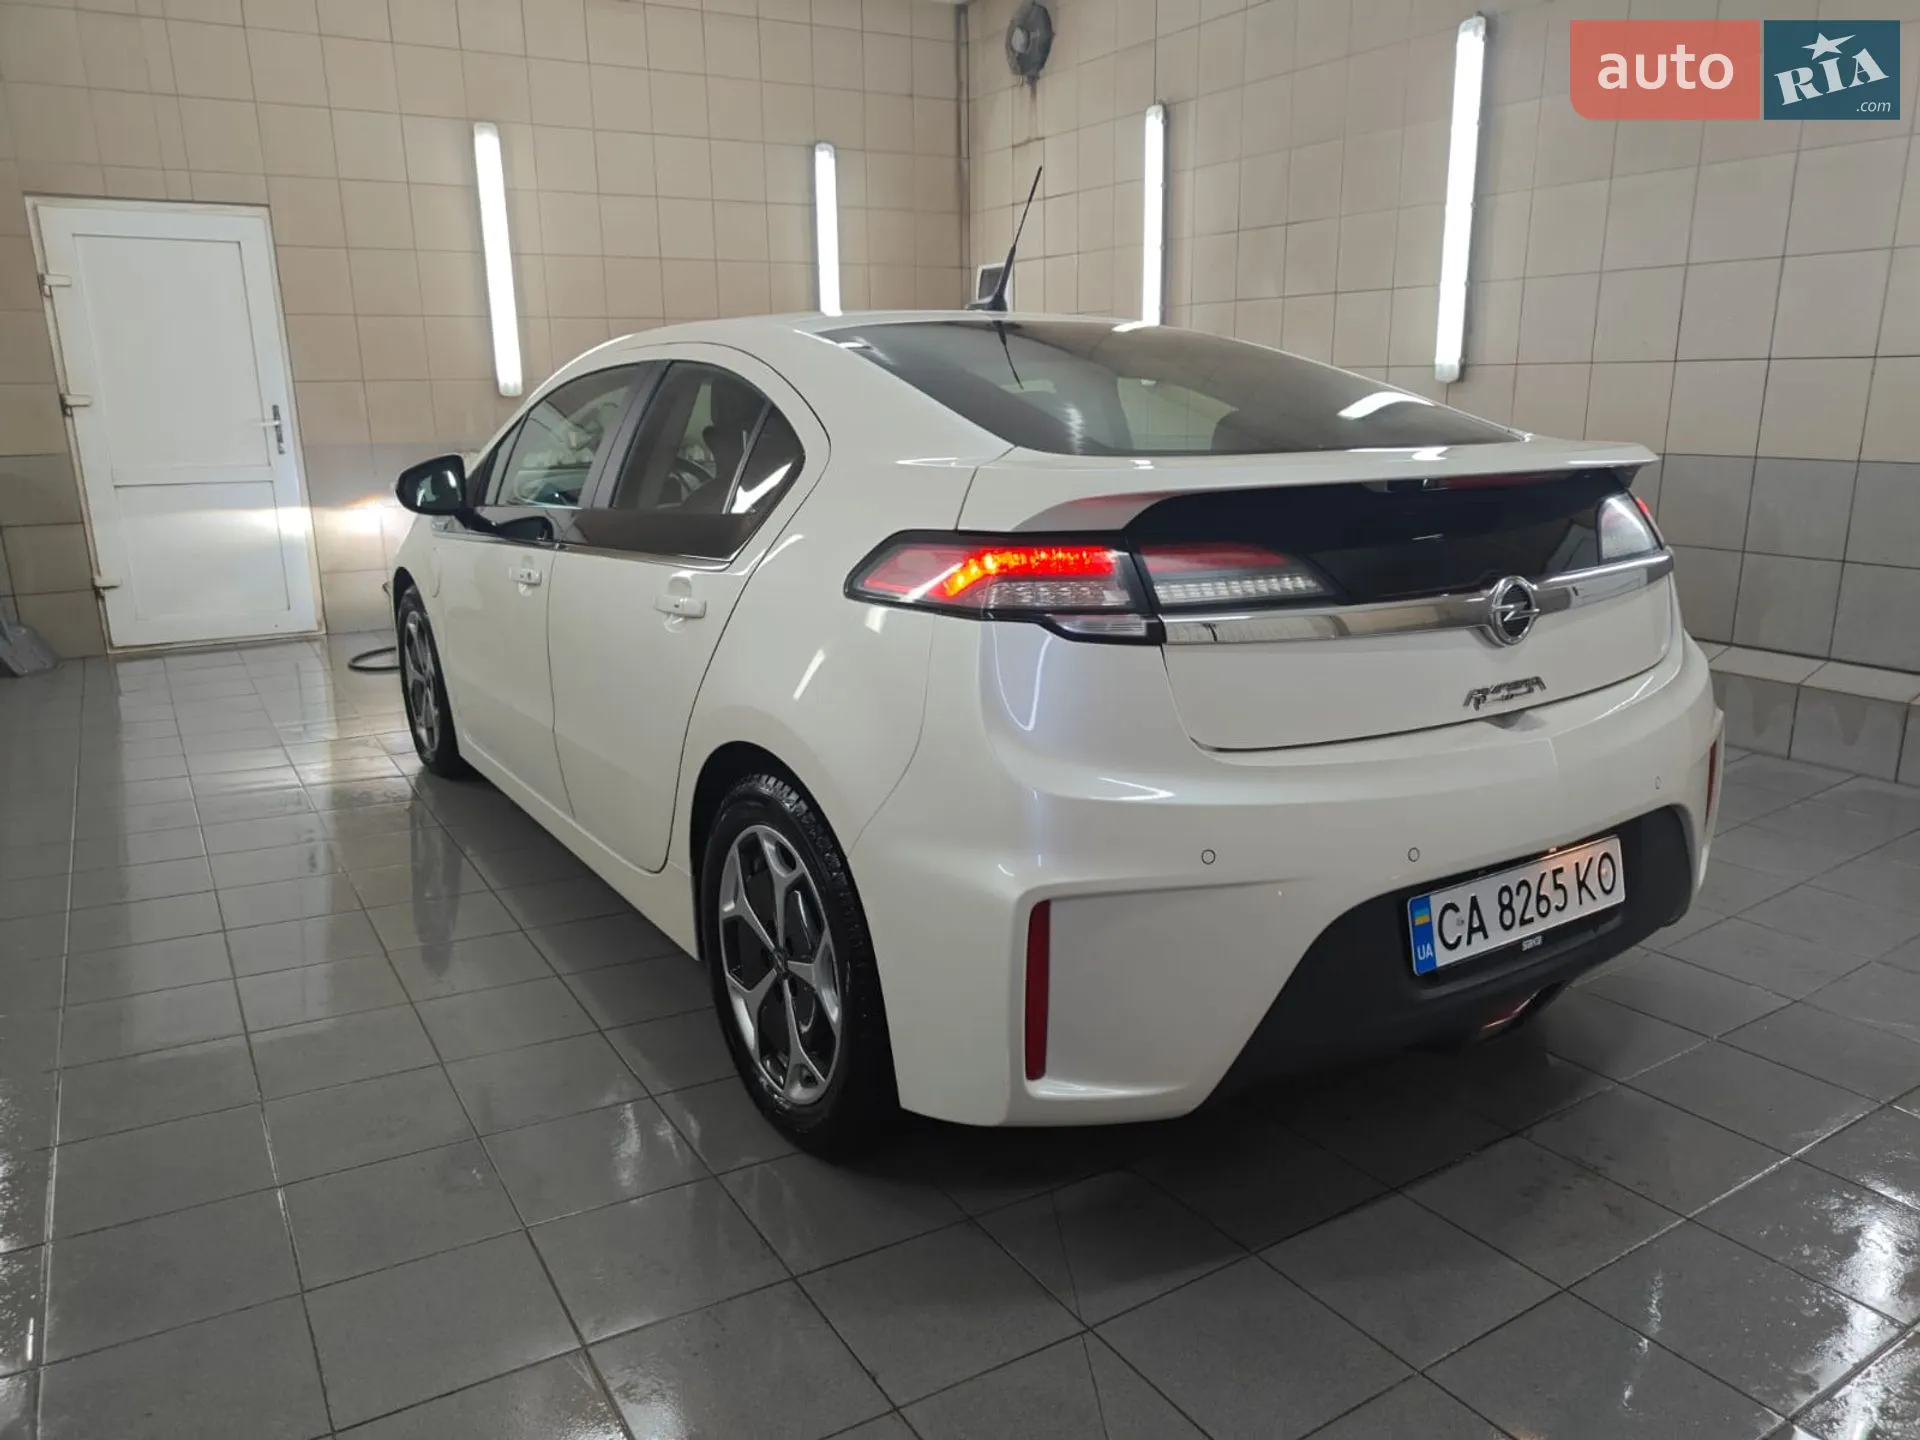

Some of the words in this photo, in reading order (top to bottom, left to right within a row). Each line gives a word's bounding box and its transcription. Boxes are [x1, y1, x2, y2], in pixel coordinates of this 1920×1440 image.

[1437, 895, 1489, 951] CA
[1497, 866, 1568, 932] 8265
[1575, 852, 1617, 906] KO
[1417, 943, 1434, 961] UA
